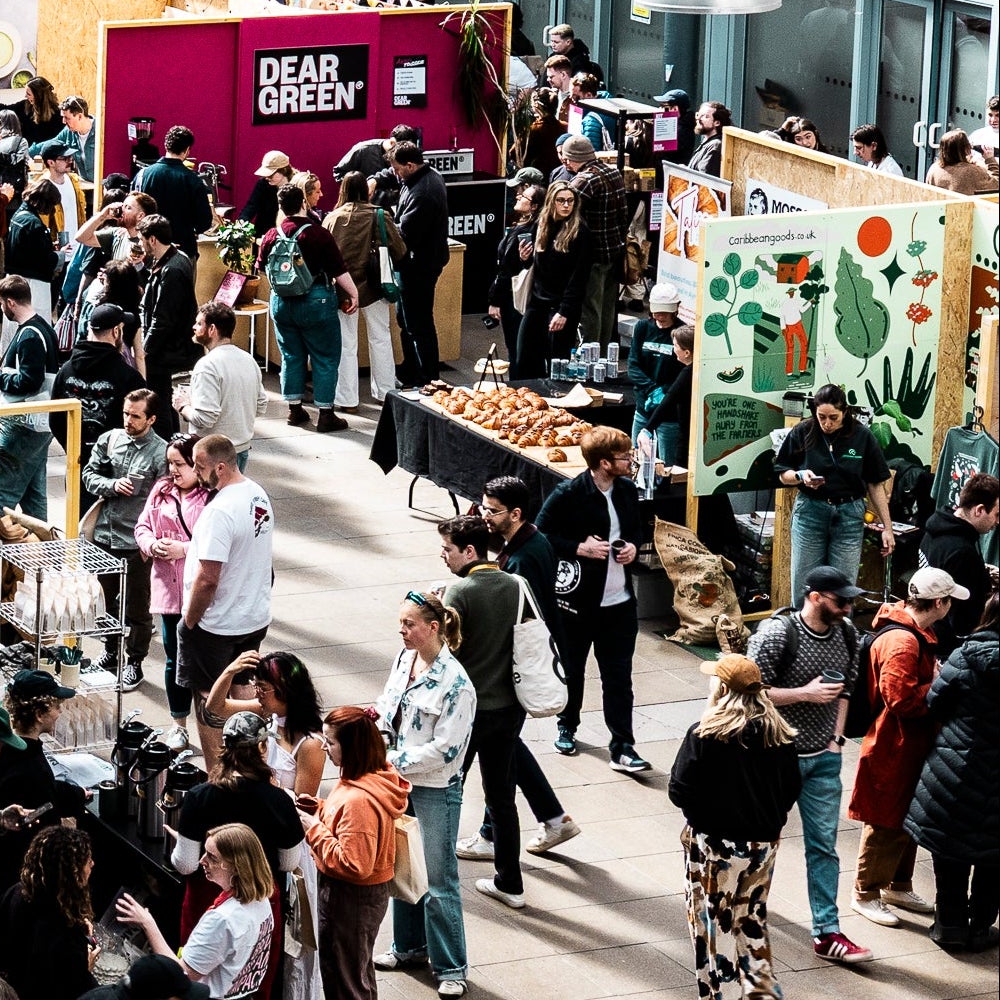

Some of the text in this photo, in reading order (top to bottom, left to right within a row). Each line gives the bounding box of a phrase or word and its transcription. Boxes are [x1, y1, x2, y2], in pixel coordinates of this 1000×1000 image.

[259, 53, 340, 87] DEAR
[711, 398, 757, 410] YOU'RE ONE
[717, 409, 760, 420] HANDSHAKE
[715, 420, 758, 431] AWAY FROM
[711, 429, 762, 441] THE FARMERS
